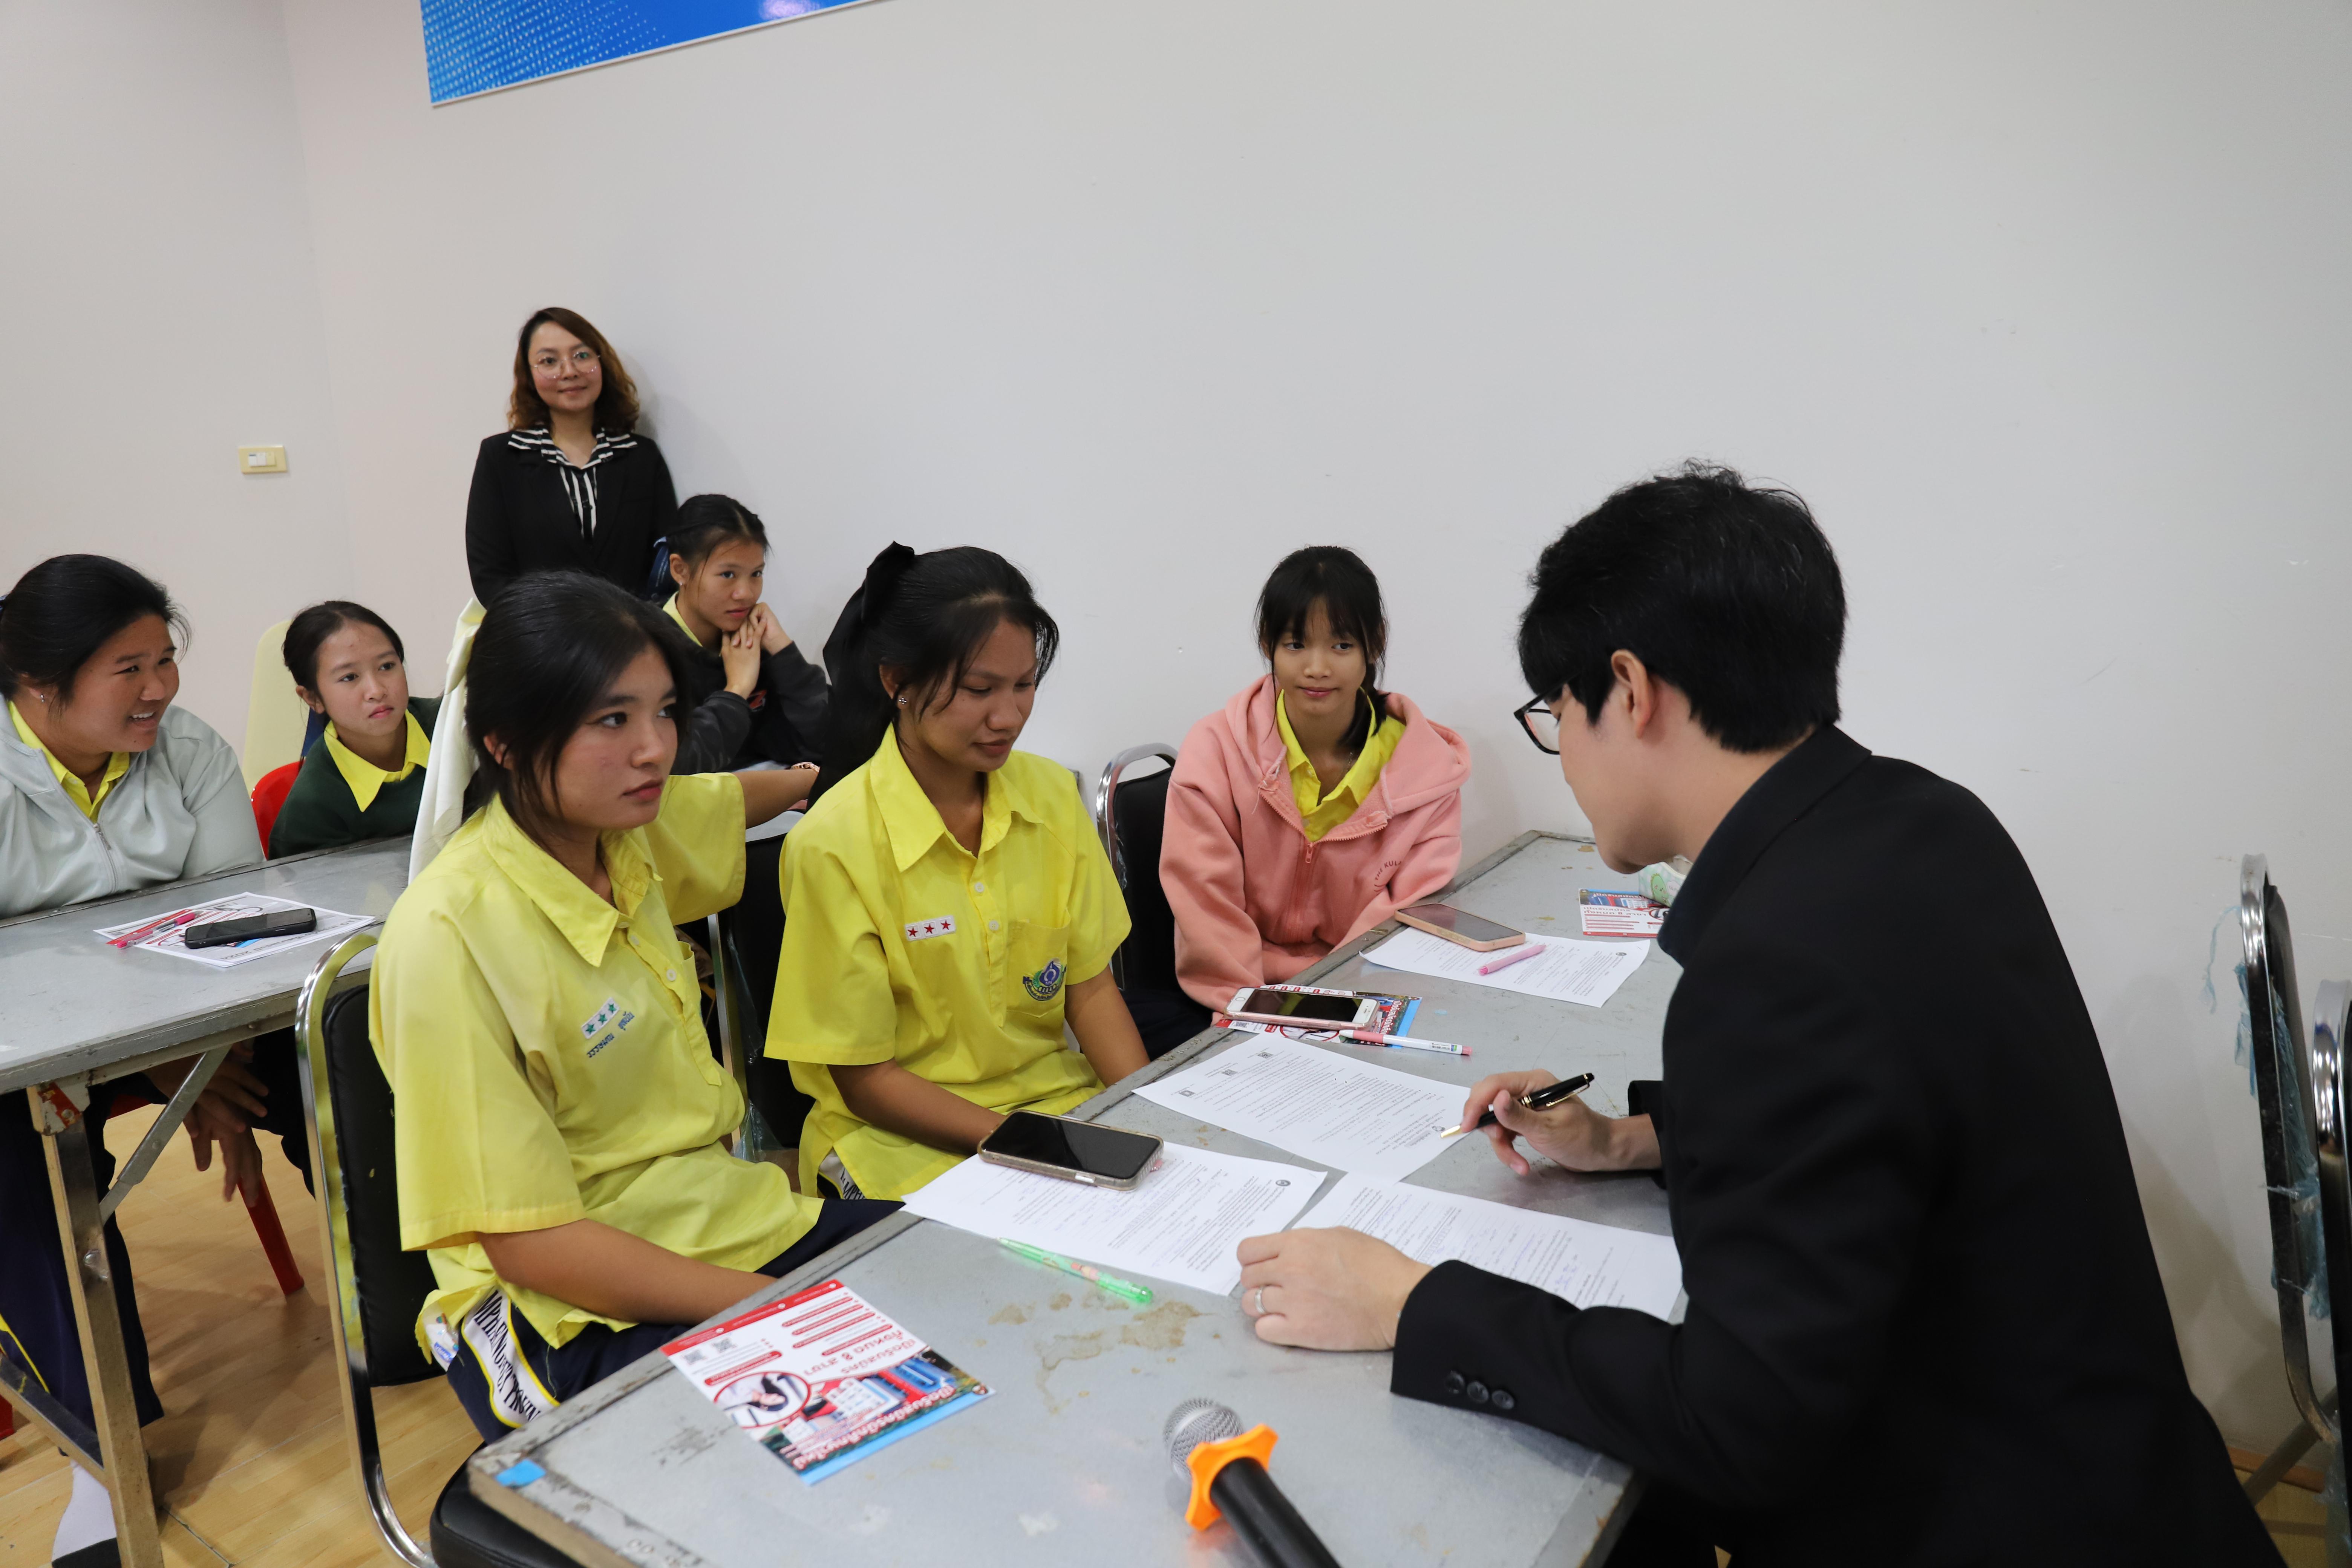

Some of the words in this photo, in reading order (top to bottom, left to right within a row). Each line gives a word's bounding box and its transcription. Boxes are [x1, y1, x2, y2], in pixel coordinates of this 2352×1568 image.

[1374, 868, 1383, 880] THE
[220, 951, 252, 960] 2024
[841, 1339, 916, 1374] เปิดรับสมัคร
[843, 1352, 854, 1361] 8
